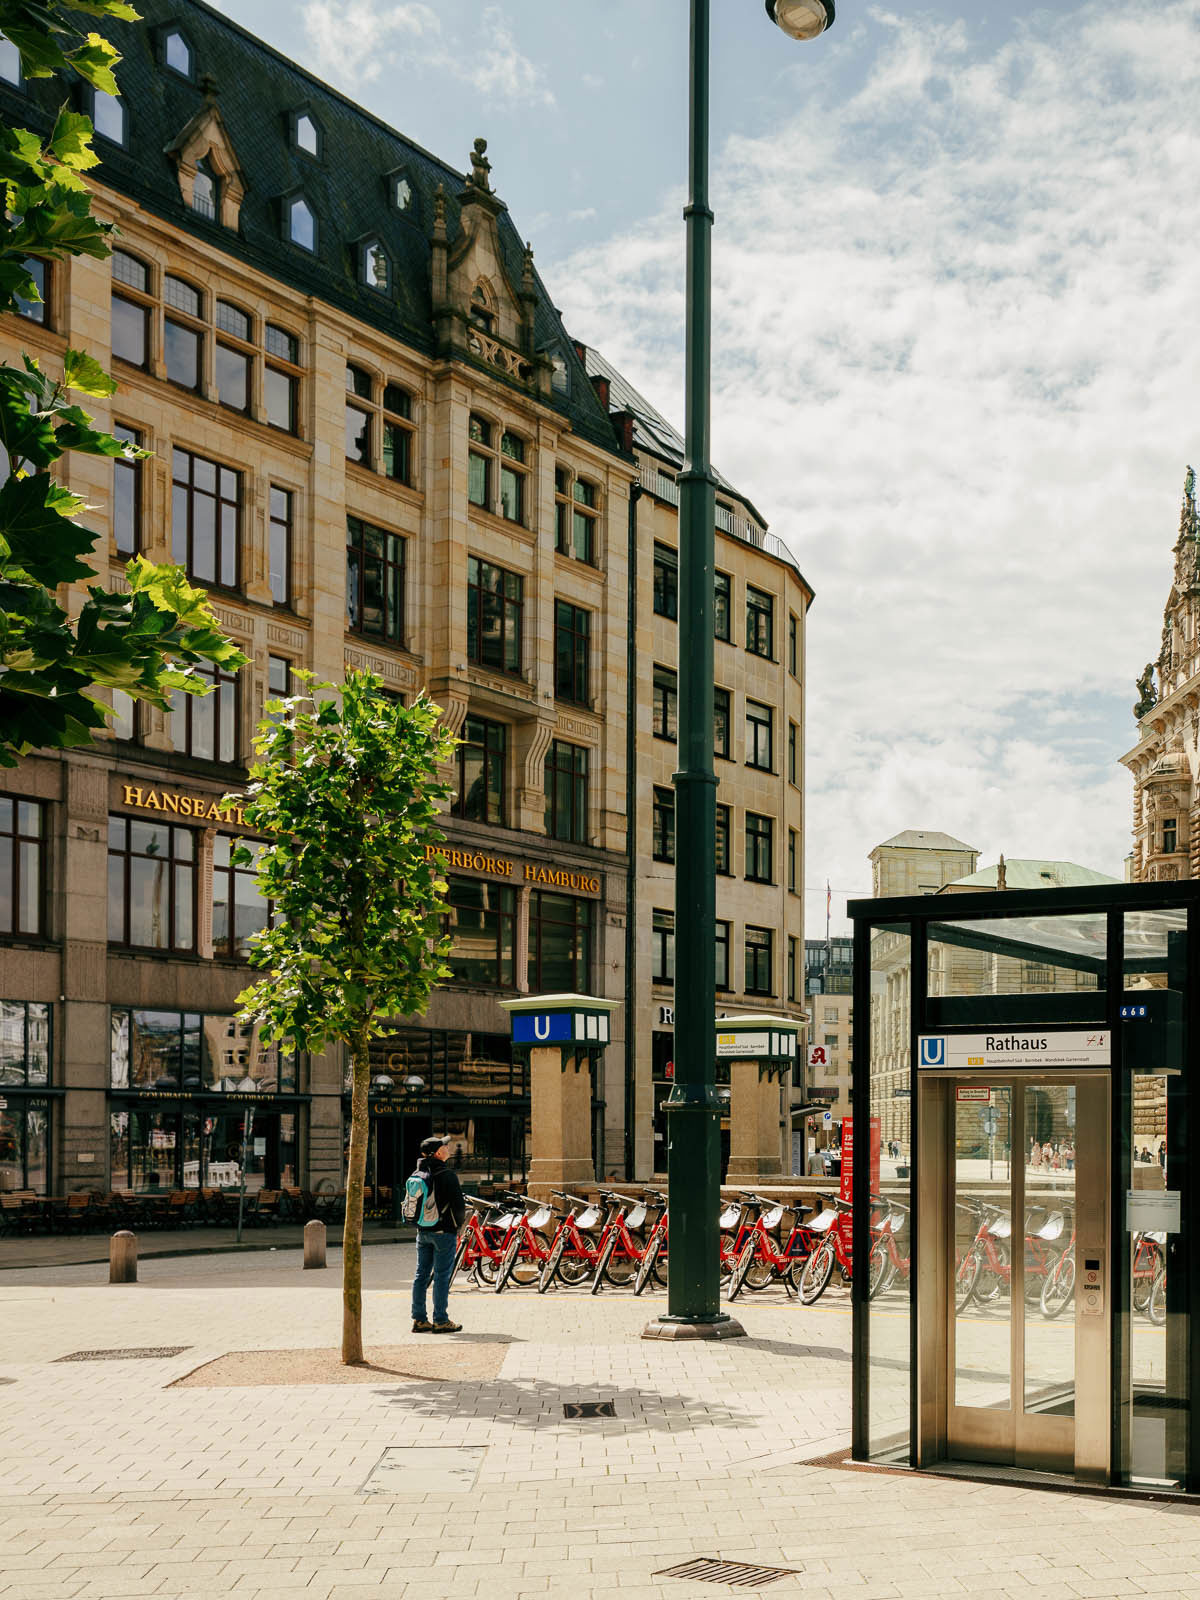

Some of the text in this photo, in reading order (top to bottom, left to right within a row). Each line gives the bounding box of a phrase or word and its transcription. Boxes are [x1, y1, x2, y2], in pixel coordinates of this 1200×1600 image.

[124, 785, 262, 828] HANSEATI
[524, 864, 600, 892] HAMBURG
[1121, 1007, 1145, 1016] 668
[534, 1015, 550, 1040] U
[986, 1036, 1047, 1051] Rathaus
[923, 1039, 942, 1064] U
[139, 1091, 193, 1100] GOLDBACH
[226, 1093, 275, 1102] GOLDBACH
[29, 1099, 48, 1107] ATM
[374, 1103, 418, 1114] GOLBACH
